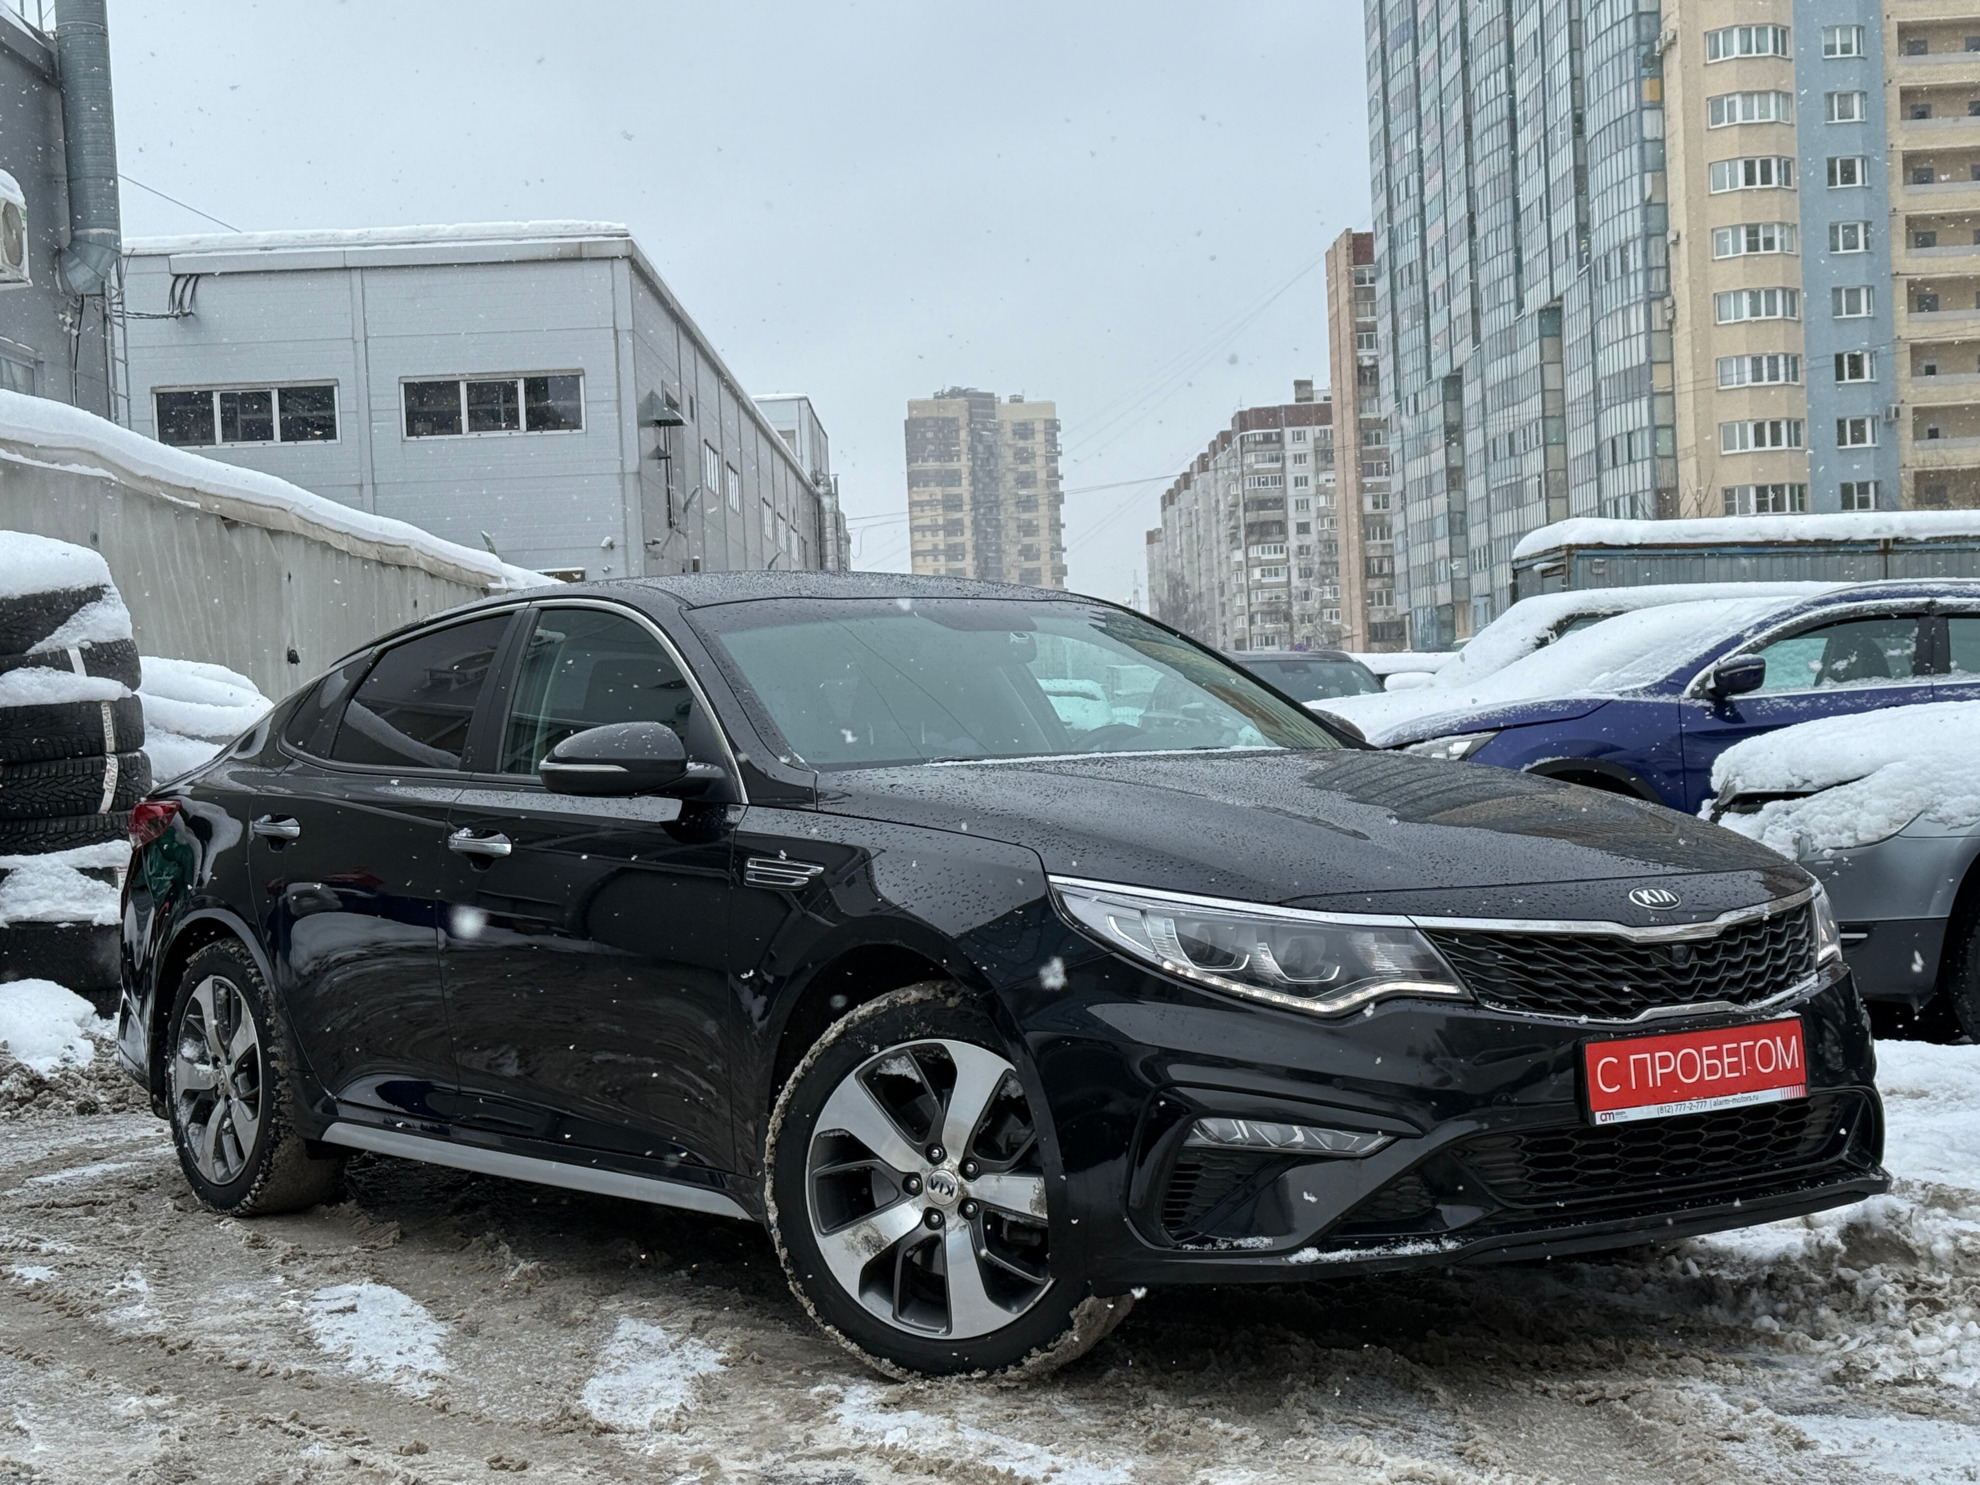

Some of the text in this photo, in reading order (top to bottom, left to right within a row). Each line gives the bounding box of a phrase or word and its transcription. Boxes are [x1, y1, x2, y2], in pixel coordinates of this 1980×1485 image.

[1634, 888, 1678, 904] KIA
[1597, 1035, 1799, 1093] С ПРОБЕГОМ
[1656, 1104, 1674, 1116] (812)
[1675, 1100, 1708, 1112] 777-2-777
[930, 1177, 955, 1198] KIA
